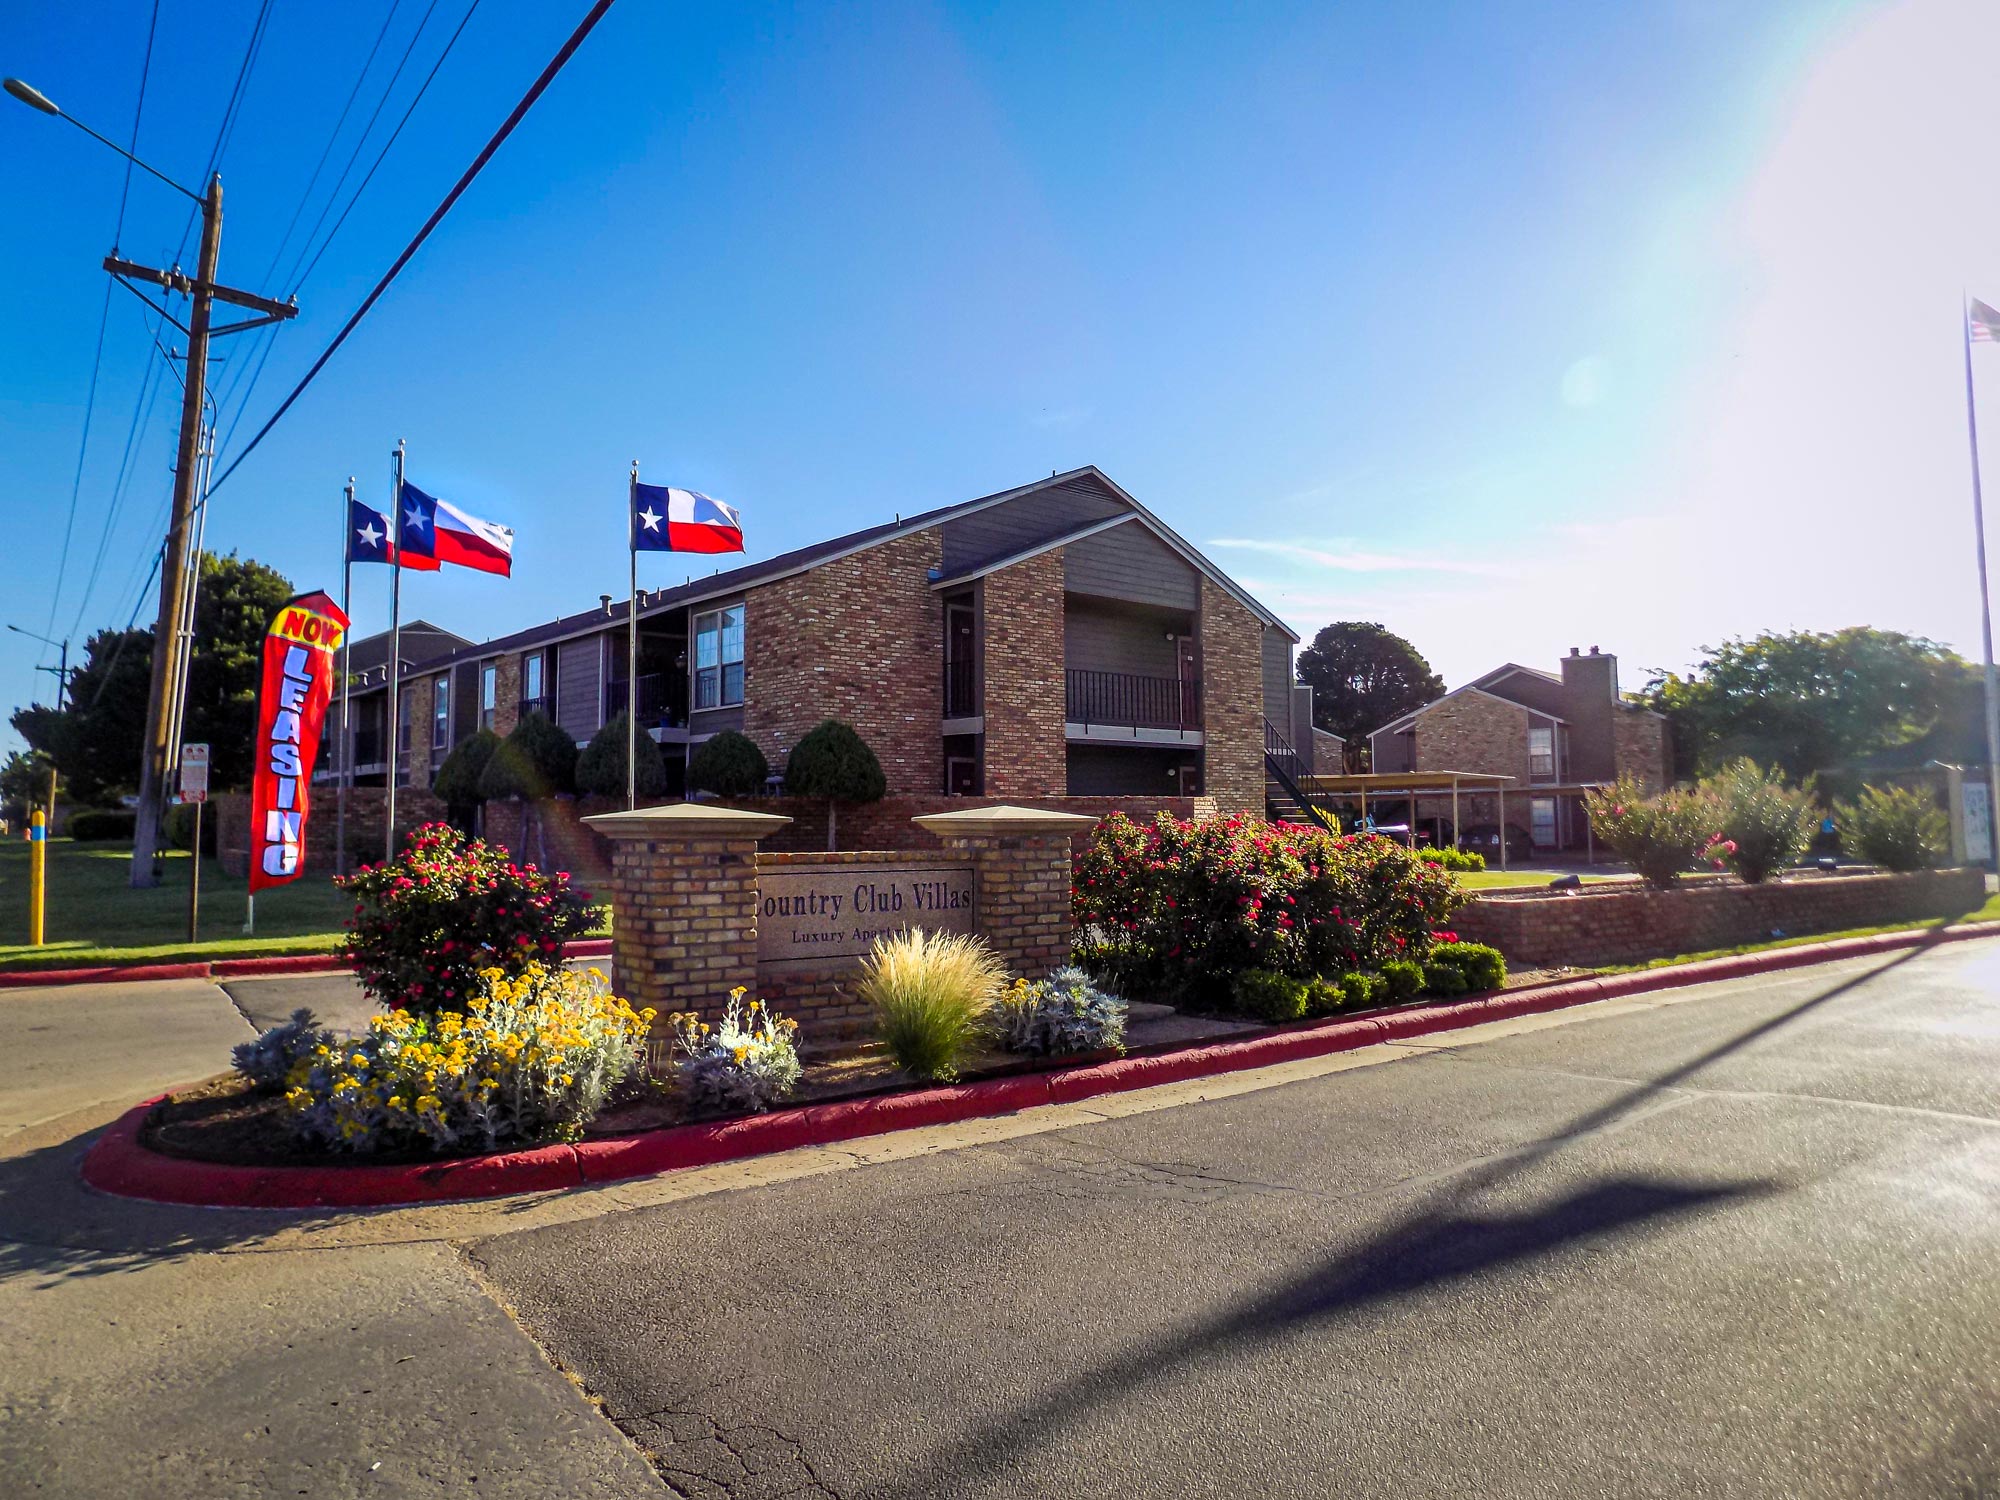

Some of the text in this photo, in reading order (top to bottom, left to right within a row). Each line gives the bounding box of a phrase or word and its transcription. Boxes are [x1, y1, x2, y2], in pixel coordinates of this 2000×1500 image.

[282, 610, 342, 647] NOW
[262, 644, 313, 876] LEASING
[853, 884, 903, 913] Club
[913, 882, 970, 909] Villas
[792, 929, 845, 944] Luxury
